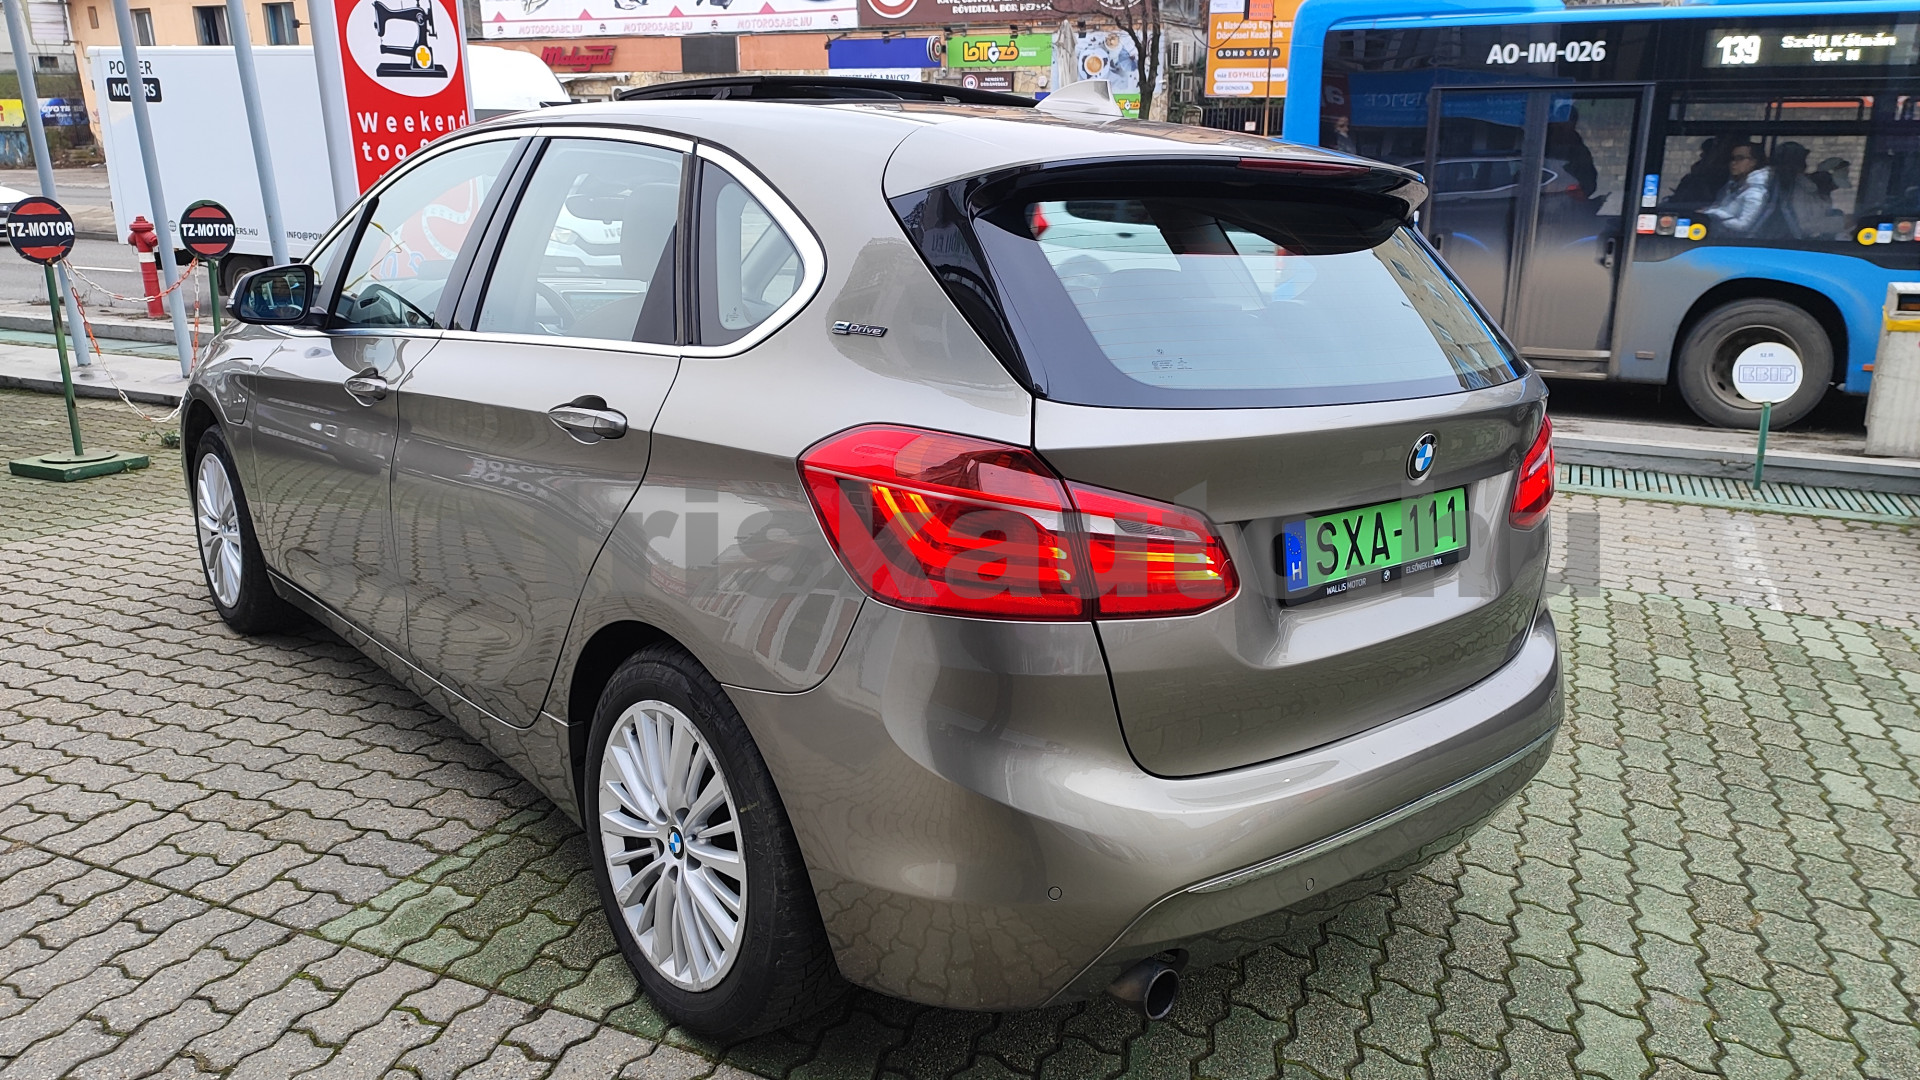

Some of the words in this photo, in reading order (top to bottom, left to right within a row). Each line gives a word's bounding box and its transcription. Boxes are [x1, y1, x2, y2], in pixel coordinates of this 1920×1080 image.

[1485, 40, 1607, 65] AO-IM-026
[1716, 34, 1762, 65] 139
[109, 60, 153, 75] POER
[112, 83, 156, 97] MORS
[357, 110, 467, 133] Weekend
[362, 141, 407, 161] too
[8, 221, 75, 237] TZ-MOTOR
[181, 223, 235, 237] TZ-MOTOR
[286, 231, 325, 240] INFO@POW
[1316, 495, 1457, 576] SXA-111
[1291, 561, 1302, 581] H
[1326, 582, 1347, 596] WALLIS
[1347, 577, 1367, 590] MOTOR
